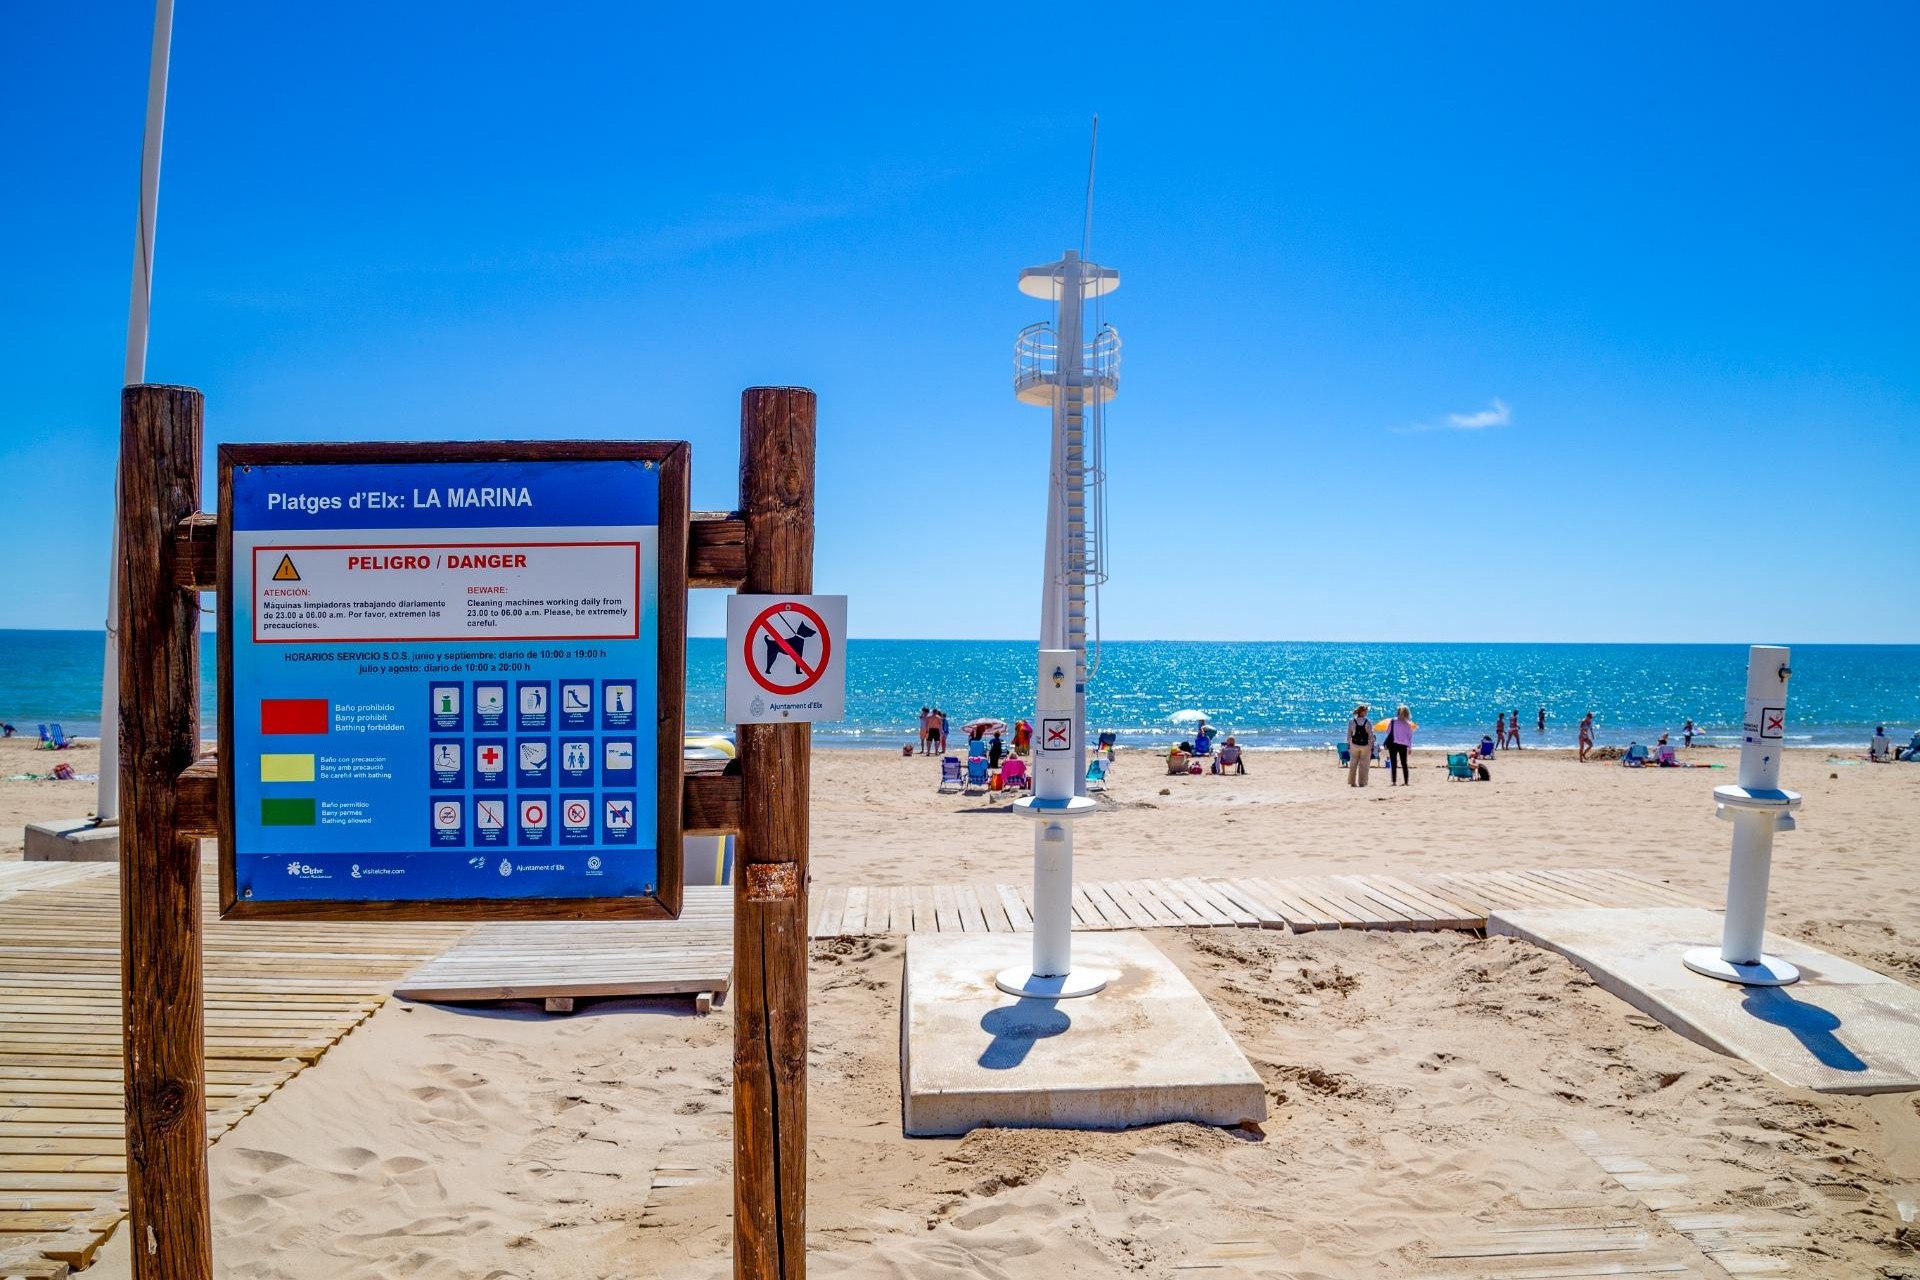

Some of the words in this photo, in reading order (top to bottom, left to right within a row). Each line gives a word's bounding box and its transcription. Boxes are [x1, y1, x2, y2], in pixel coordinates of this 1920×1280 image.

[268, 493, 342, 515] Platges
[414, 488, 441, 508] LA
[447, 487, 532, 508] MARINA
[348, 555, 430, 570] PELIGRO
[436, 555, 441, 570] /
[448, 554, 527, 568] DANGER
[264, 588, 311, 597] ATENCIÓN:
[468, 586, 508, 594] BEWARE:
[264, 600, 302, 610] Máquinas
[304, 600, 351, 610] limpiadoras
[353, 600, 396, 610] trabajando
[398, 600, 446, 608] diariamente
[468, 599, 502, 608] Cleaning
[546, 598, 578, 607] working
[581, 598, 600, 606] daily
[364, 611, 387, 619] favor,
[544, 608, 574, 617] Please,
[588, 608, 627, 617] extremely
[264, 622, 320, 631] precauciones.
[285, 652, 334, 662] HORARIOS
[337, 652, 380, 661] SERVICIO
[383, 652, 410, 660] S.O.S.
[412, 652, 434, 661] junio
[436, 653, 442, 661] y
[444, 651, 496, 660] septiembre:
[499, 650, 524, 659] diario
[527, 650, 537, 659] de
[540, 650, 564, 658] 10:00
[574, 650, 598, 658] 19:00
[600, 649, 606, 658] h
[359, 664, 377, 674] julio
[380, 666, 386, 674] y
[388, 664, 421, 674] agosto:
[424, 664, 449, 672] diario
[451, 663, 462, 672] de
[466, 663, 488, 672] 10:00
[357, 704, 395, 712] prohibido
[770, 702, 806, 711] Ajuntament
[335, 714, 354, 722] Bany
[357, 714, 387, 722] prohibit
[335, 724, 365, 732] Bathing
